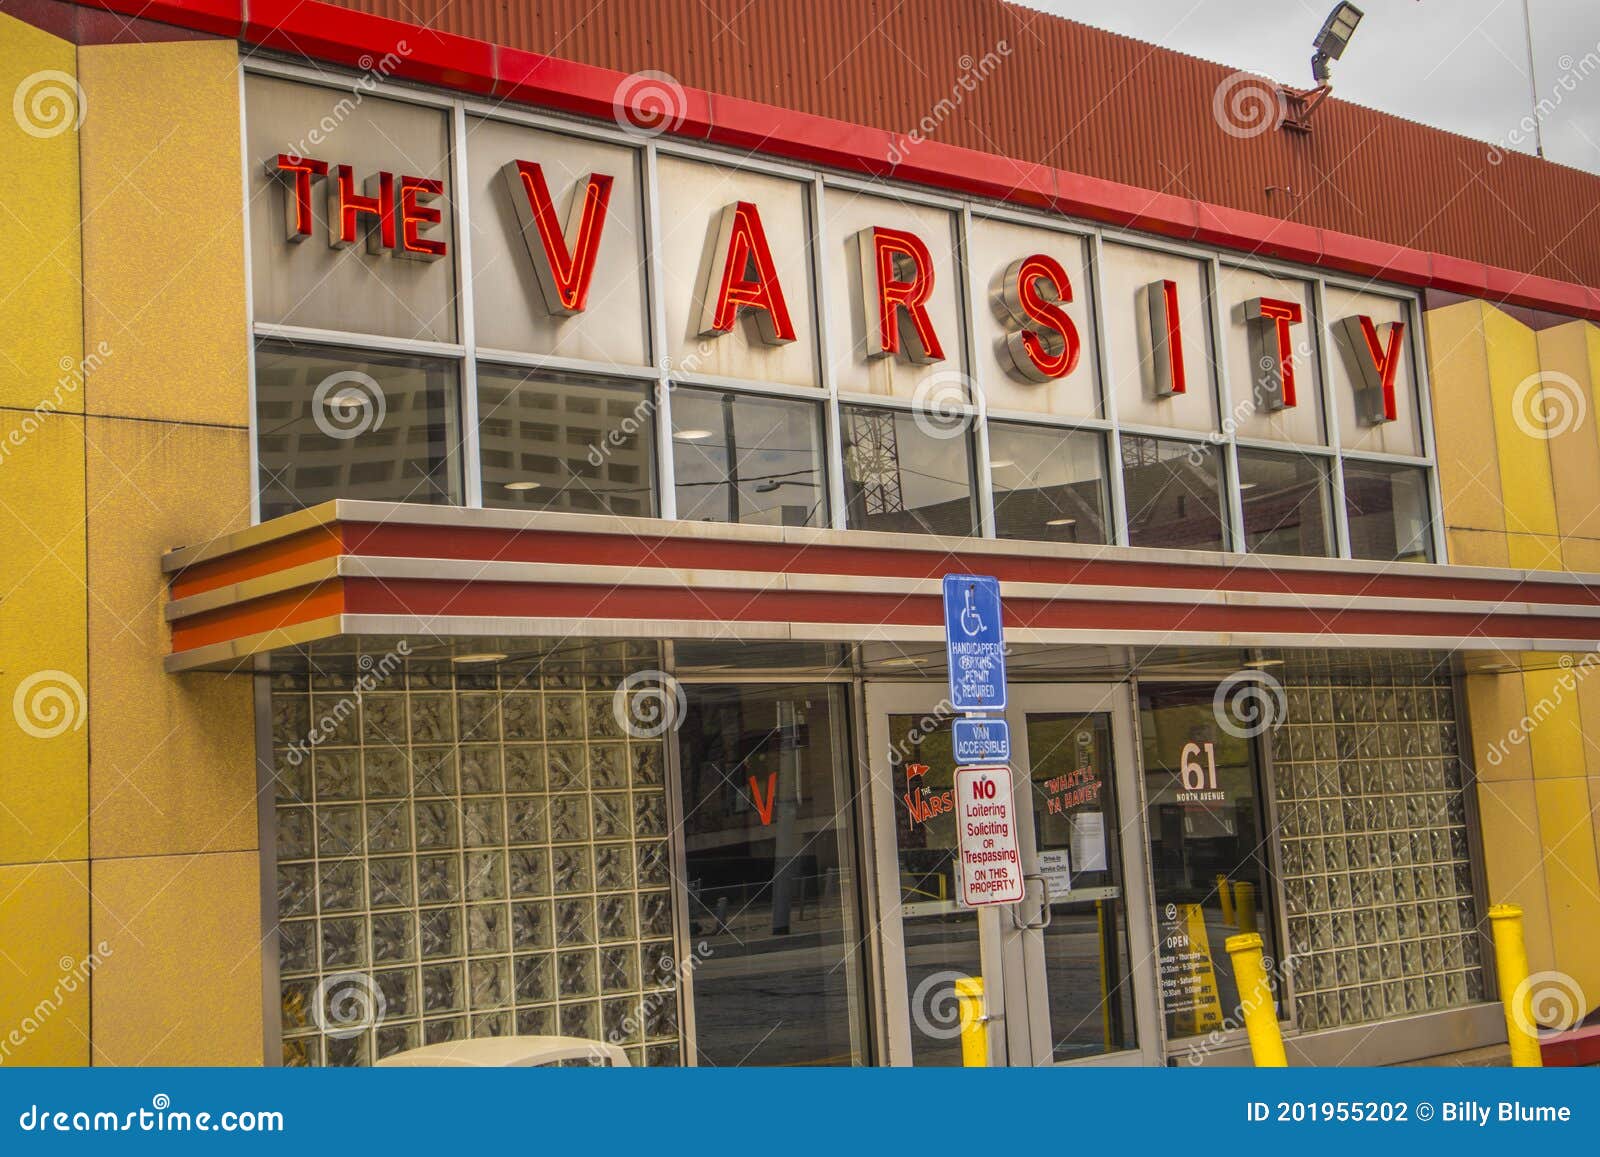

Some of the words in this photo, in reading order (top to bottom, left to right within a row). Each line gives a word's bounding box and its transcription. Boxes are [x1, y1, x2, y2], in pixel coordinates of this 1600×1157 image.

[268, 154, 447, 260] THE
[504, 159, 1405, 424] VARSITY
[952, 642, 1000, 655] HANDICAPPED
[961, 656, 993, 669] PARKING
[964, 671, 990, 683] PERMIT
[962, 685, 995, 698] REQUIRED
[972, 727, 990, 740] VAN
[958, 741, 1007, 754] ACCESSIBLE
[1181, 742, 1217, 790] 61
[921, 786, 932, 796] THE
[972, 780, 996, 800] NO
[1176, 792, 1199, 802] NORTH
[1200, 791, 1225, 801] AVENUE
[749, 772, 777, 825] V
[966, 803, 1007, 819] Loitering
[967, 821, 1009, 838] Soliciting
[982, 839, 995, 849] OR
[964, 848, 1017, 866] Trespassing
[974, 869, 986, 881] ON
[989, 867, 1008, 879] THIS
[969, 879, 1016, 894] PROPERTY
[1167, 935, 1189, 949] OPEN
